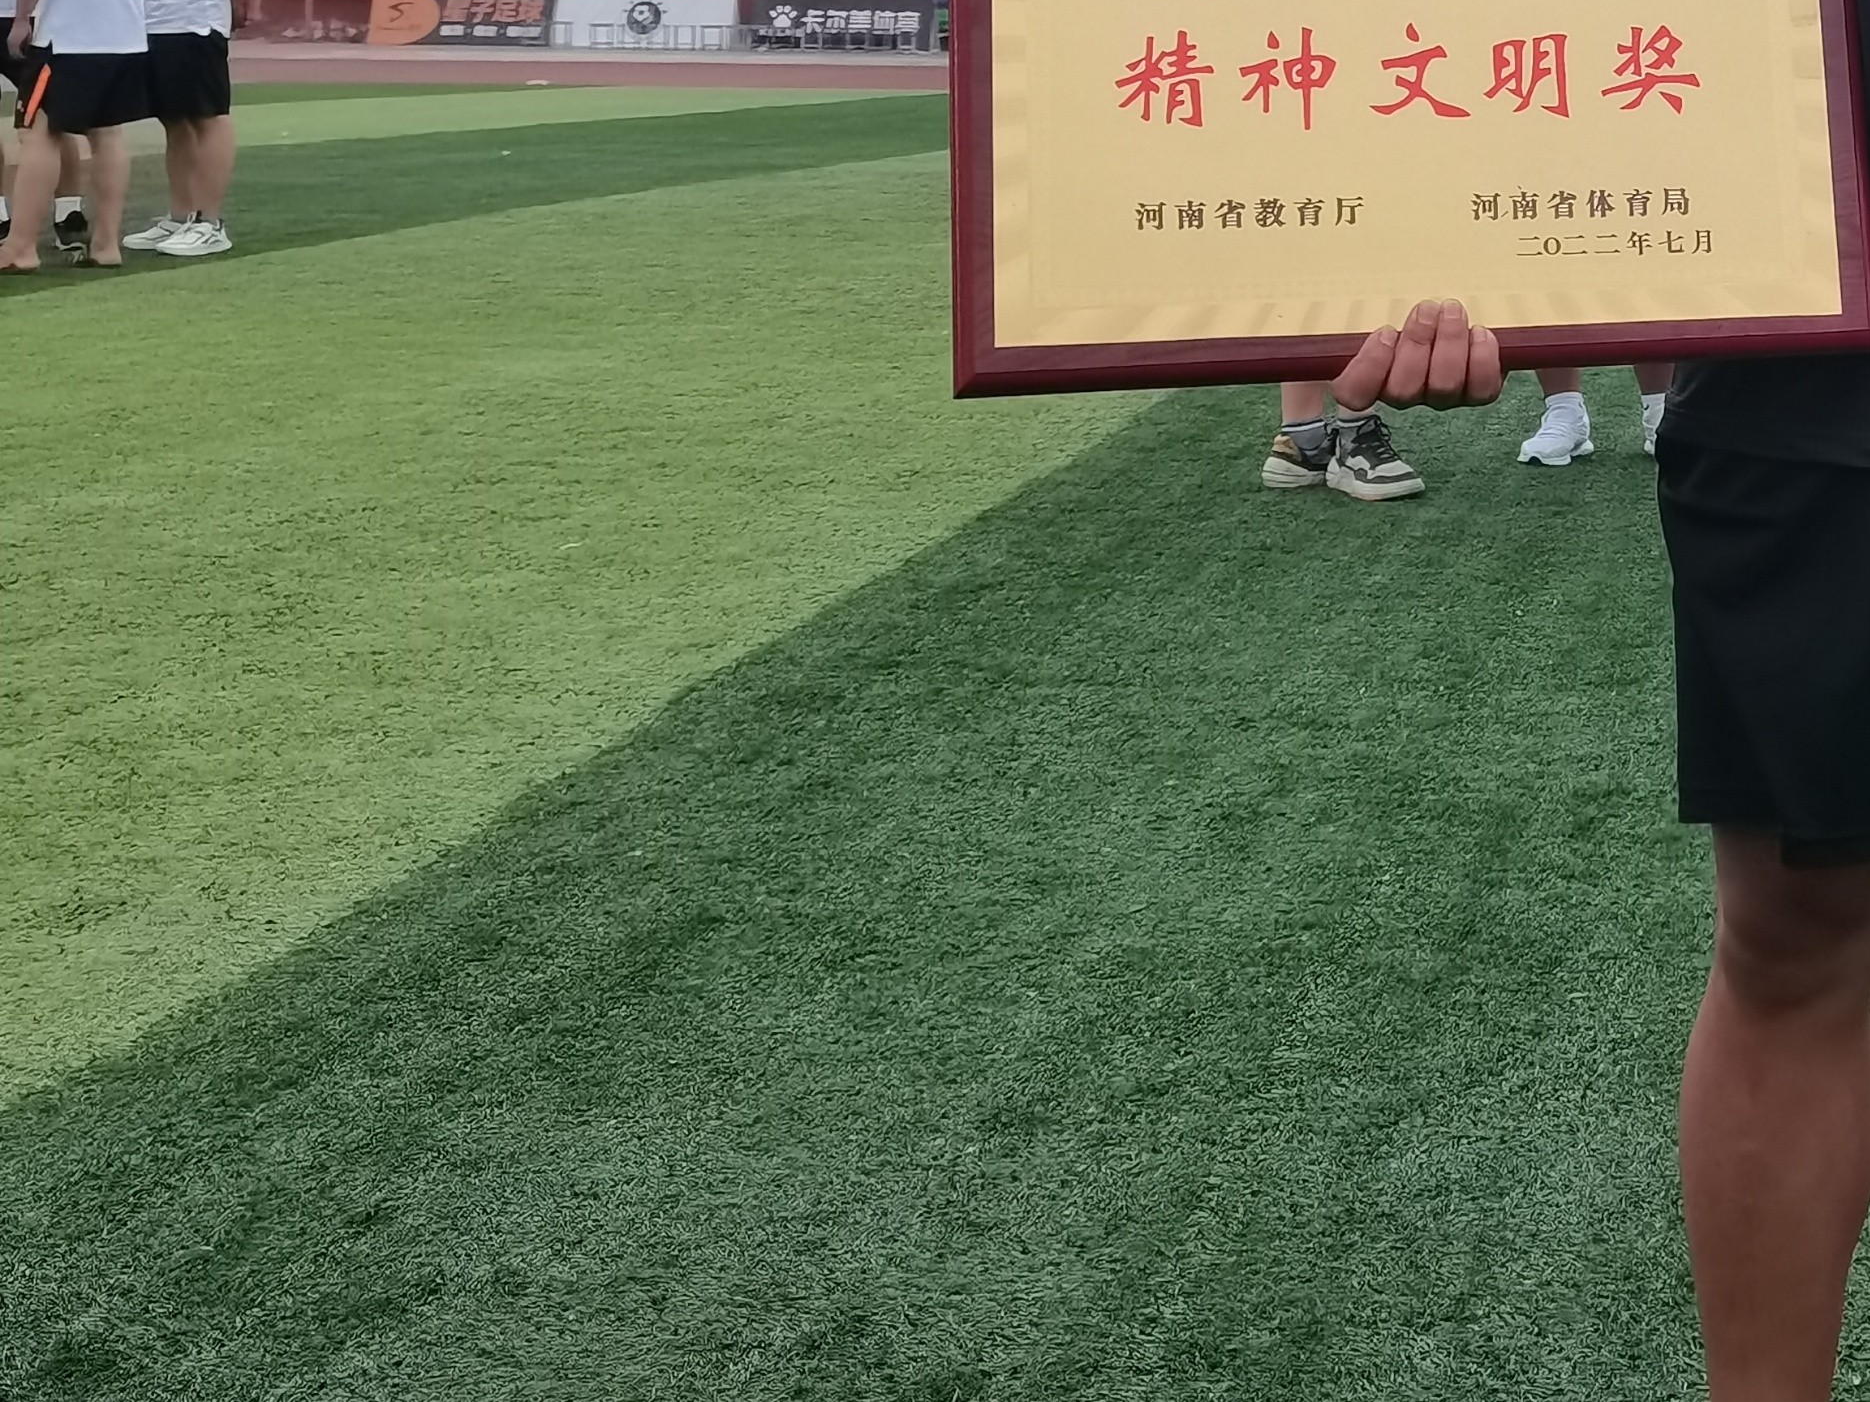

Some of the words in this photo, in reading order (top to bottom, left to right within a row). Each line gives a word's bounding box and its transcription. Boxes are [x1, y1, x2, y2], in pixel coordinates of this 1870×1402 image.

[1115, 22, 1701, 131] 精神文明奖
[1134, 196, 1365, 231] 河南省教育厅
[1471, 187, 1690, 221] 河南省体育局
